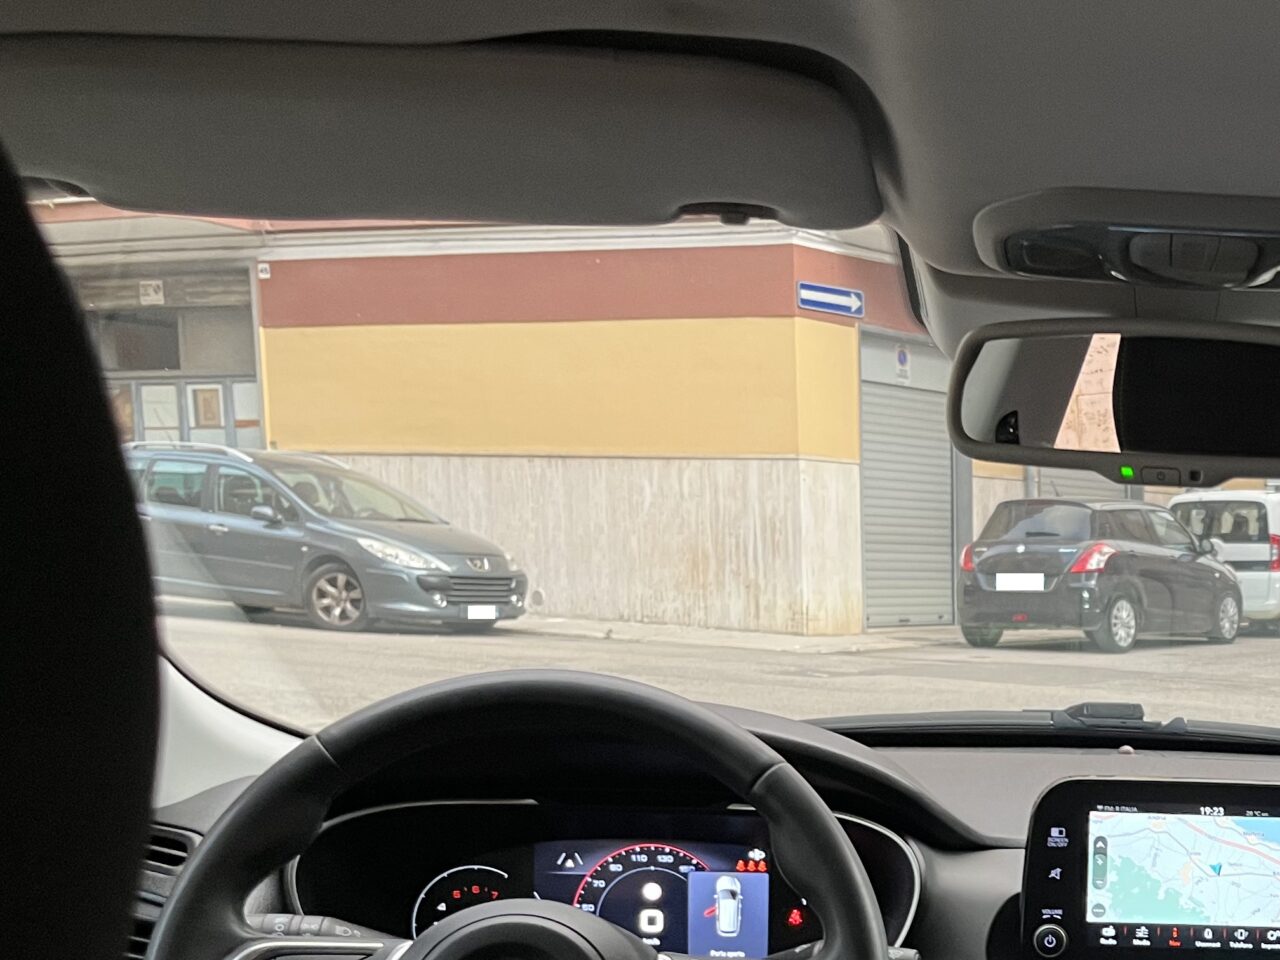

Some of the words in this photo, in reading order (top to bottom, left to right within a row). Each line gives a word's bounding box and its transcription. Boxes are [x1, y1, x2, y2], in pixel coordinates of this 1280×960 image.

[1200, 806, 1225, 816] 19:23
[631, 854, 648, 862] 110
[592, 879, 606, 888] 70
[491, 891, 499, 899] 7
[437, 902, 447, 911] 4
